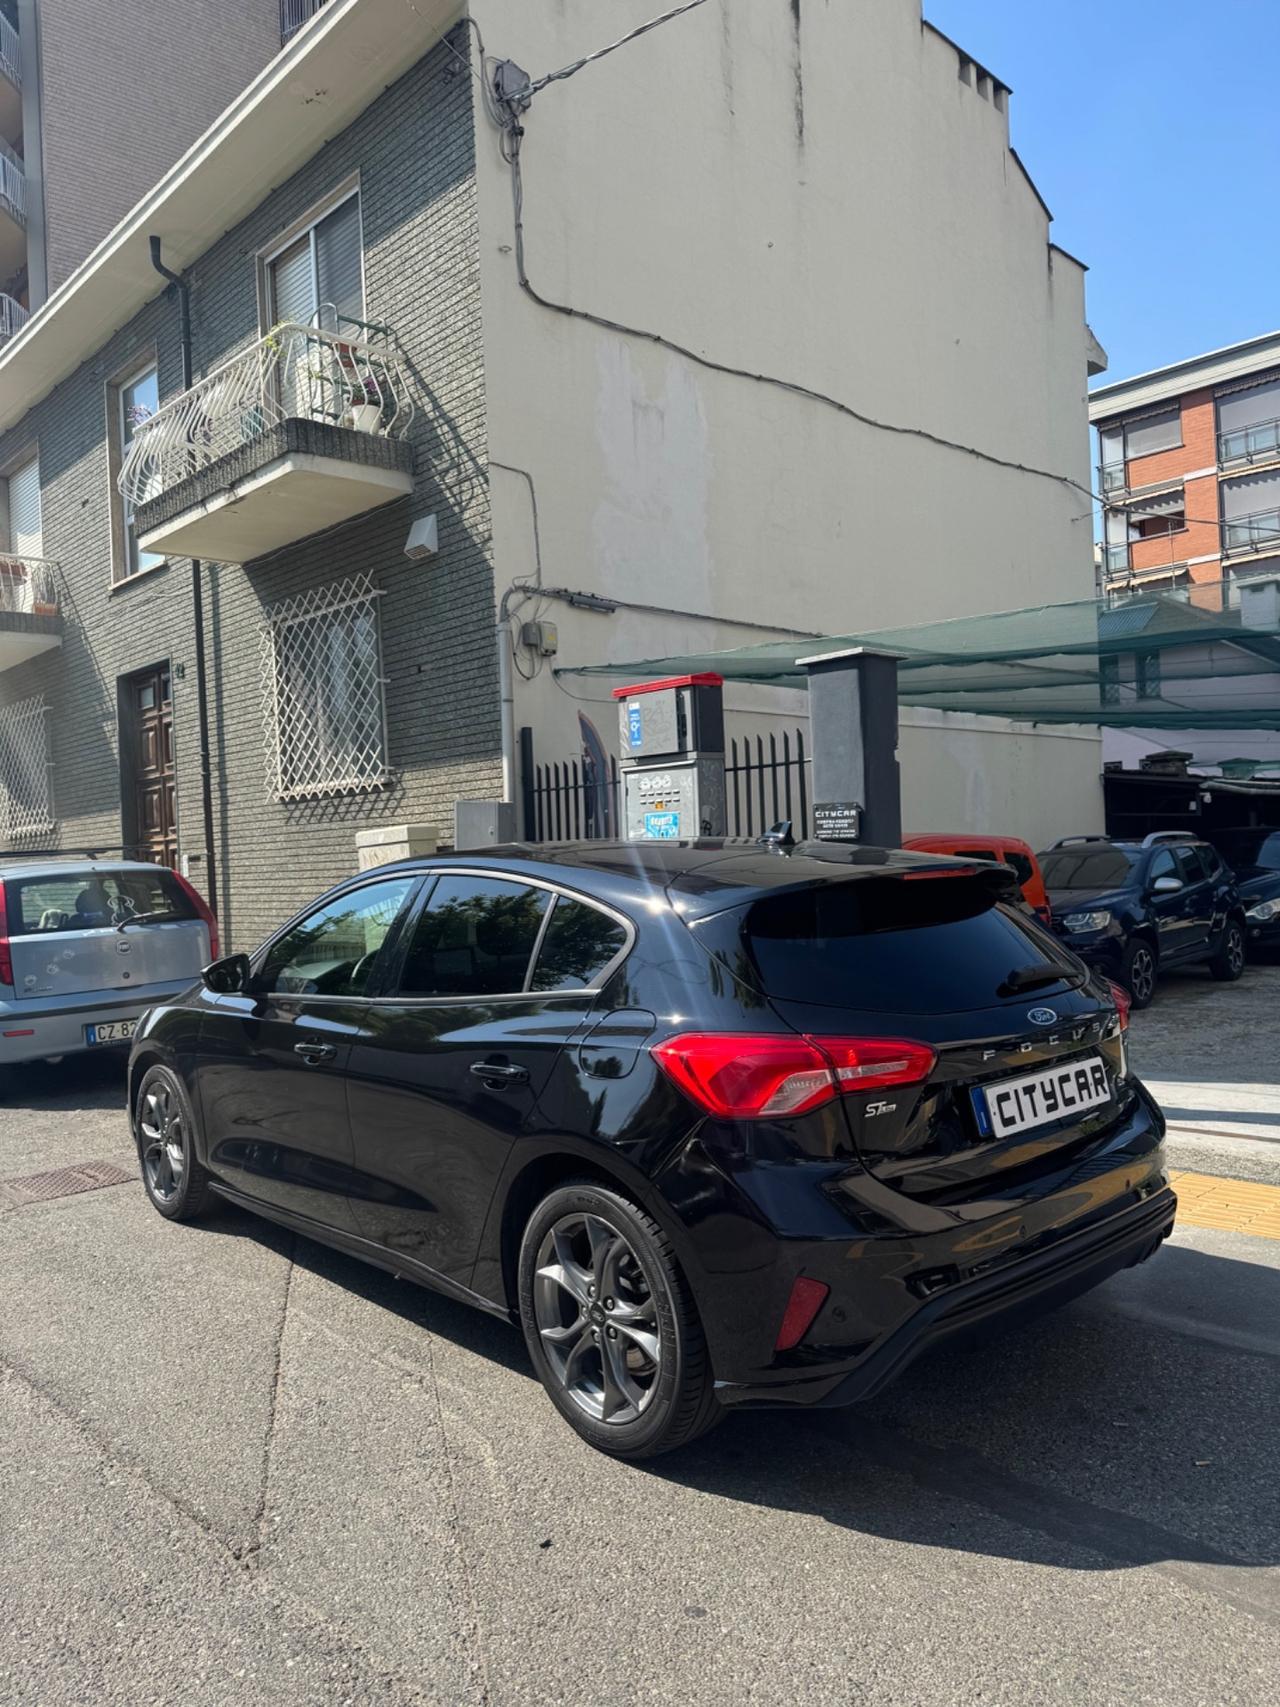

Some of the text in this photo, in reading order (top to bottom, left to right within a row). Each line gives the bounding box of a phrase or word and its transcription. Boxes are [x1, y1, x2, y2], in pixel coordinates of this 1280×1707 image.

[815, 810, 857, 818] CITYCAR
[97, 1024, 116, 1040] CZ
[983, 1022, 1100, 1061] FOCUS
[996, 1064, 1108, 1128] CITYCAR
